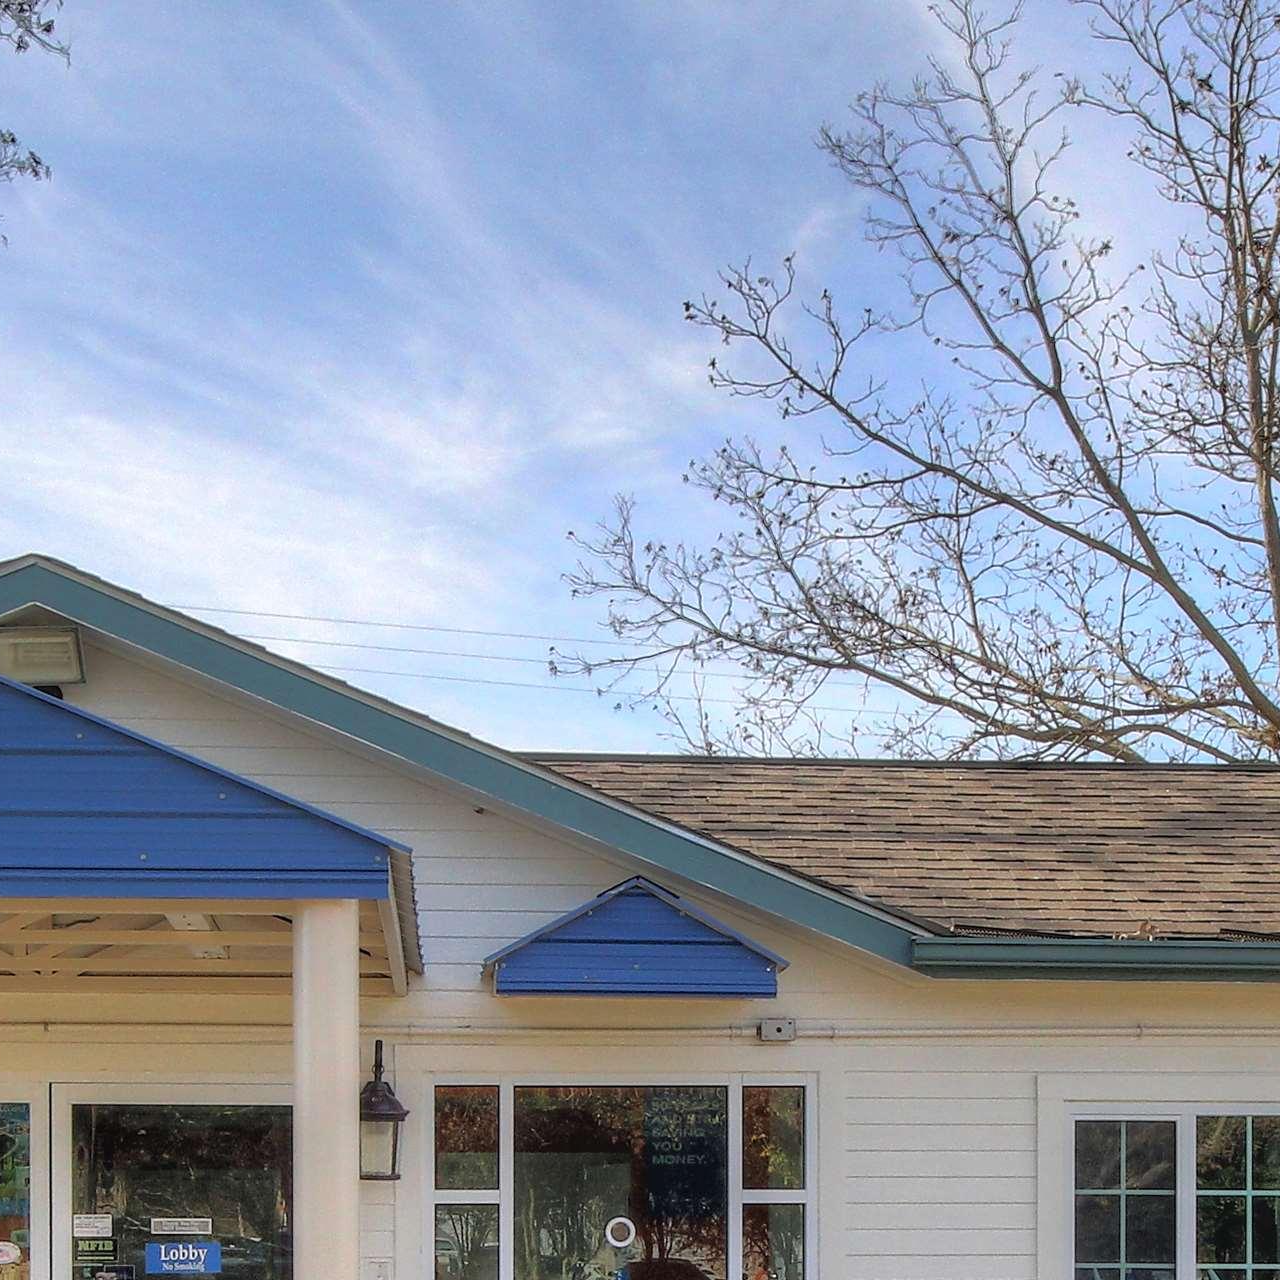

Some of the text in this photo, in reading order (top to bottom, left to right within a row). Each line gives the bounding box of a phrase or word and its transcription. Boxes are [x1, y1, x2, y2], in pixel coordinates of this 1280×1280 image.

[652, 1141, 682, 1151] YOU
[652, 1155, 706, 1164] MONEY.
[160, 1244, 208, 1264] Lobby
[162, 1262, 205, 1272] No Smoking
